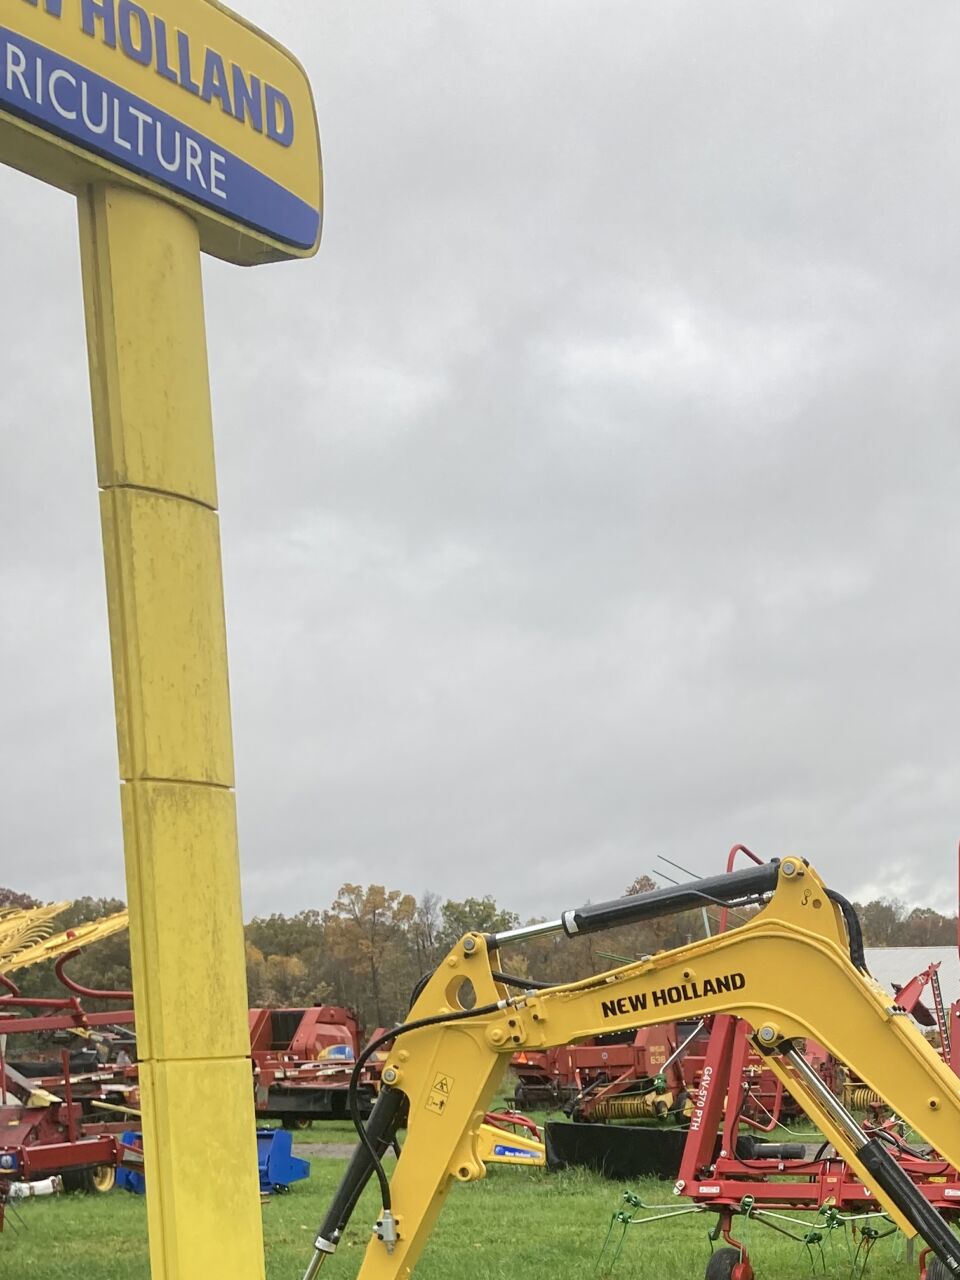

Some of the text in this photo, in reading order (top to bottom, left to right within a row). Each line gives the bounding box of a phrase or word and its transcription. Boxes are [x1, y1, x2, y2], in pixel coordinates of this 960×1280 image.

[6, 42, 228, 200] RICULTURE
[81, 0, 294, 148] HOLLAND
[601, 972, 746, 1018] NEW HOLLAND
[690, 1066, 713, 1131] G4V-570 PTH
